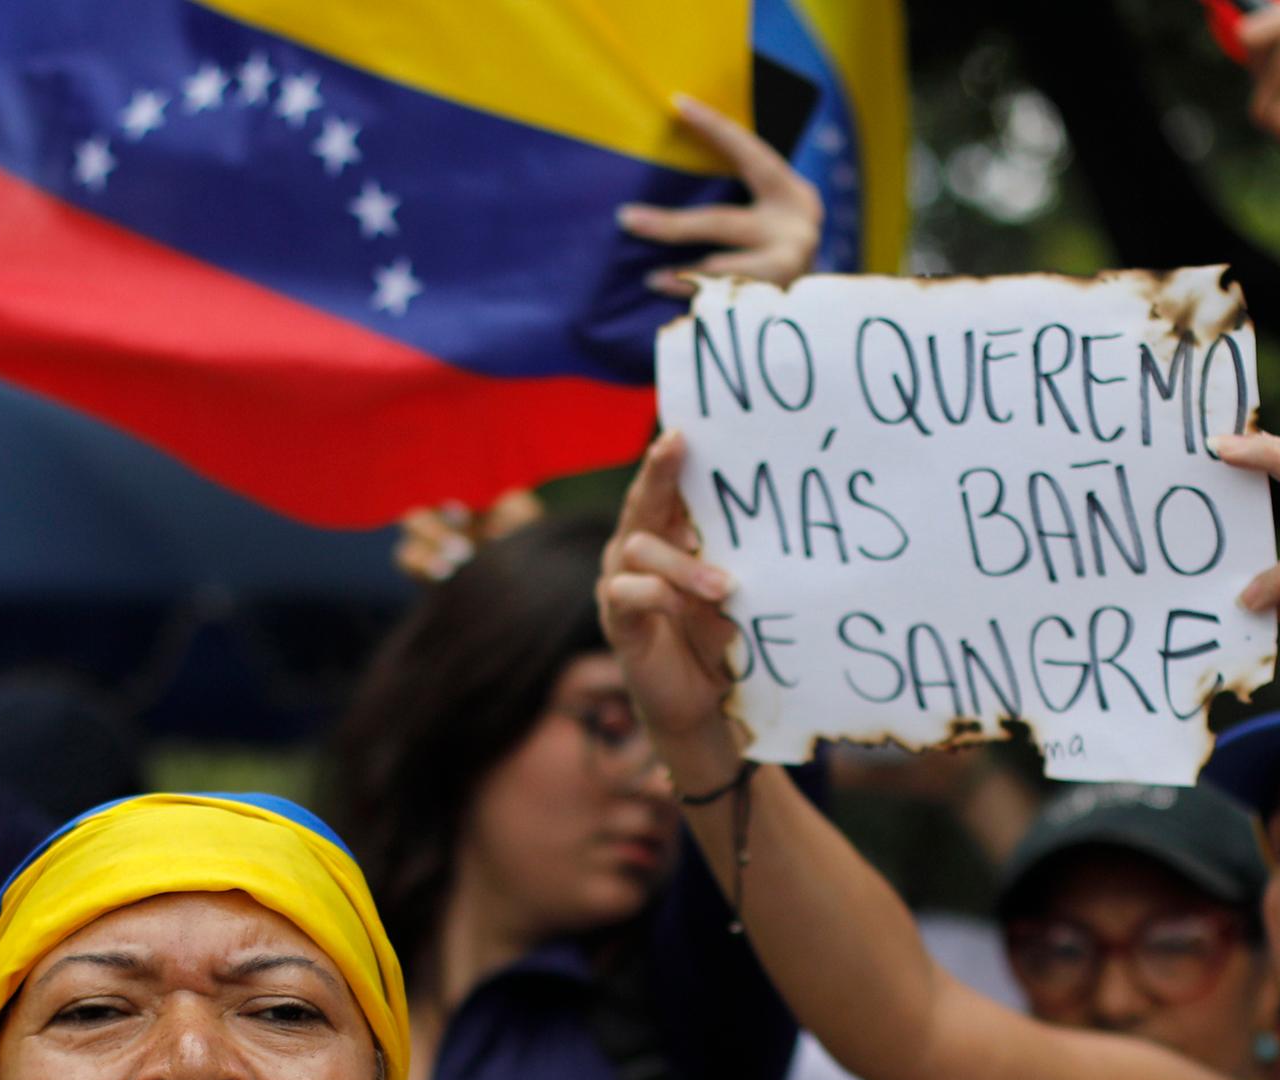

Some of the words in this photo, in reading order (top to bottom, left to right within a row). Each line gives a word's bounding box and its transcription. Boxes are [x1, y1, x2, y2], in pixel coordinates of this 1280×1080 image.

[691, 306, 816, 419] NO
[710, 427, 910, 565] MÁS
[957, 459, 1226, 584] BAÑO
[835, 605, 1223, 722] SANGRE
